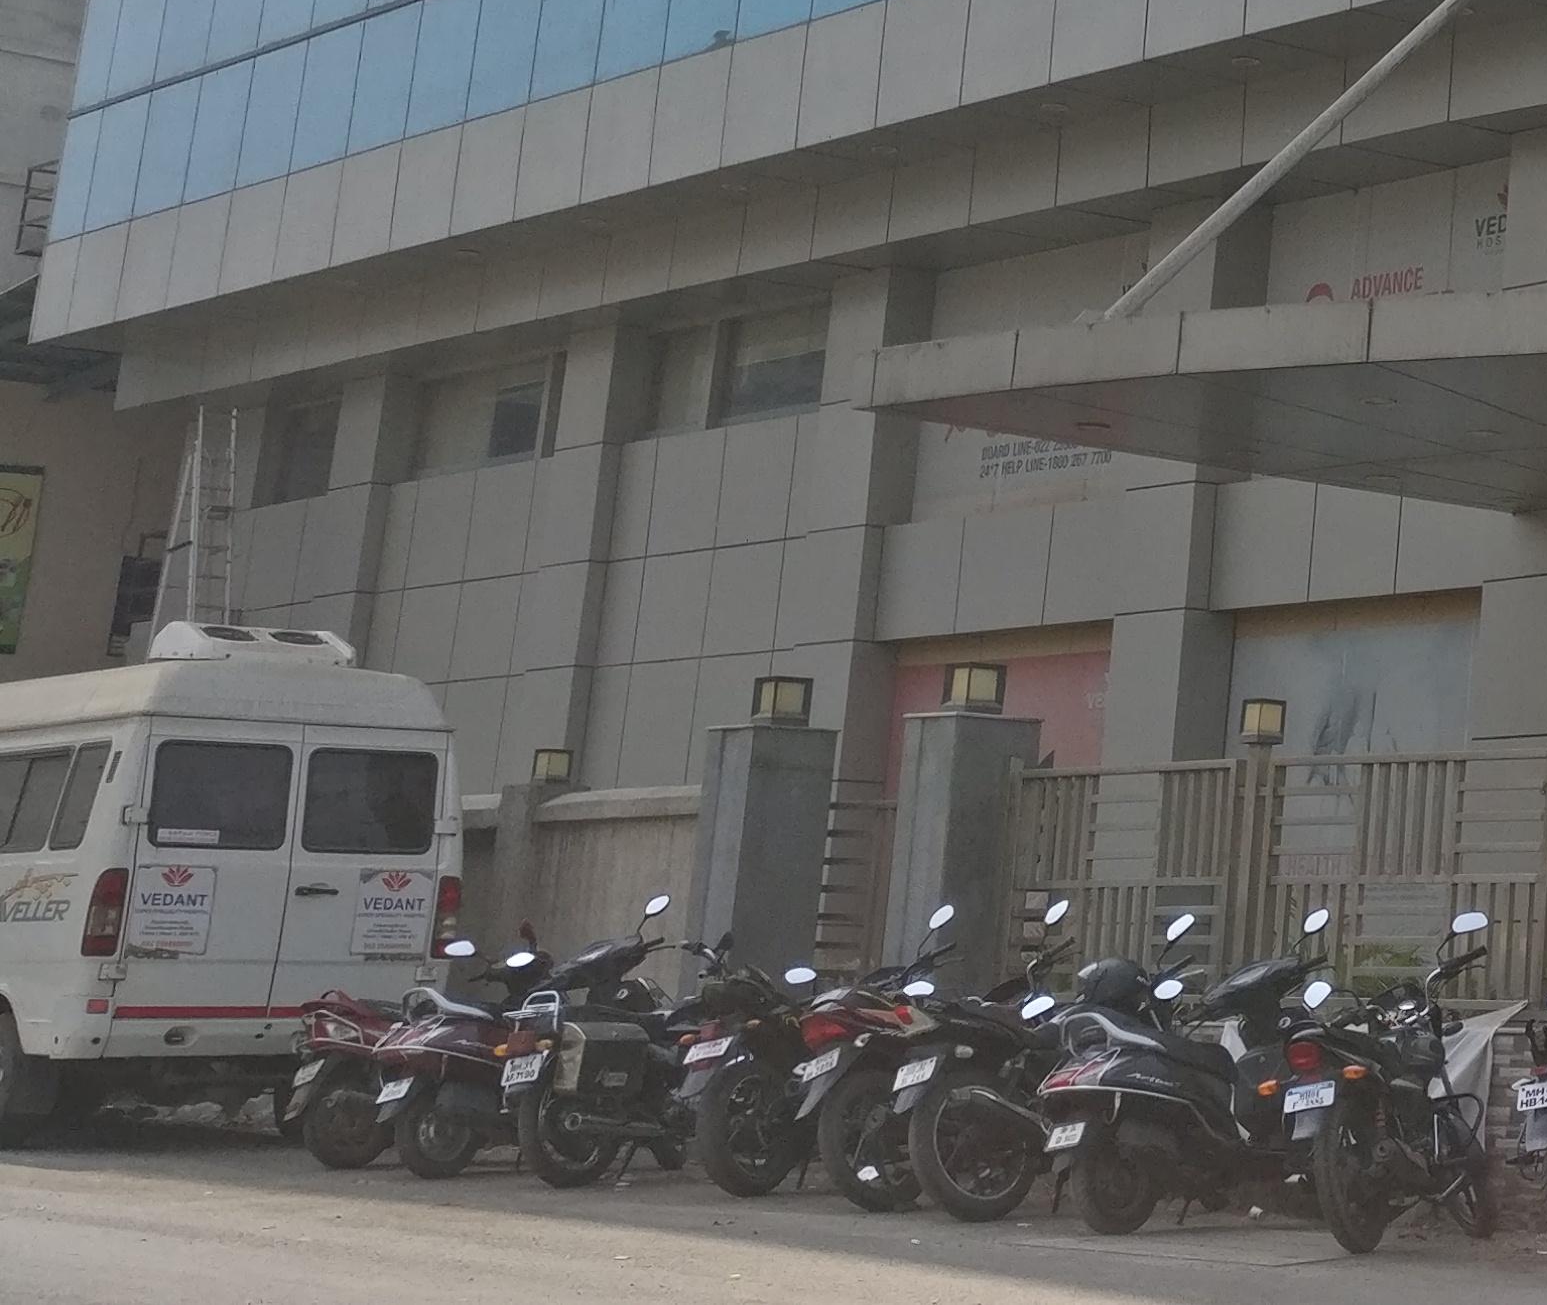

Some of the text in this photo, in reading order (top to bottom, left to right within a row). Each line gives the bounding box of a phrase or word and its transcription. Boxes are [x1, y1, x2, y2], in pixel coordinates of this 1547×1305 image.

[1350, 266, 1424, 300] ADVANCE
[141, 893, 208, 907] VEDANT
[364, 897, 426, 911] VEDANT
[1526, 1087, 1544, 1098] MH
